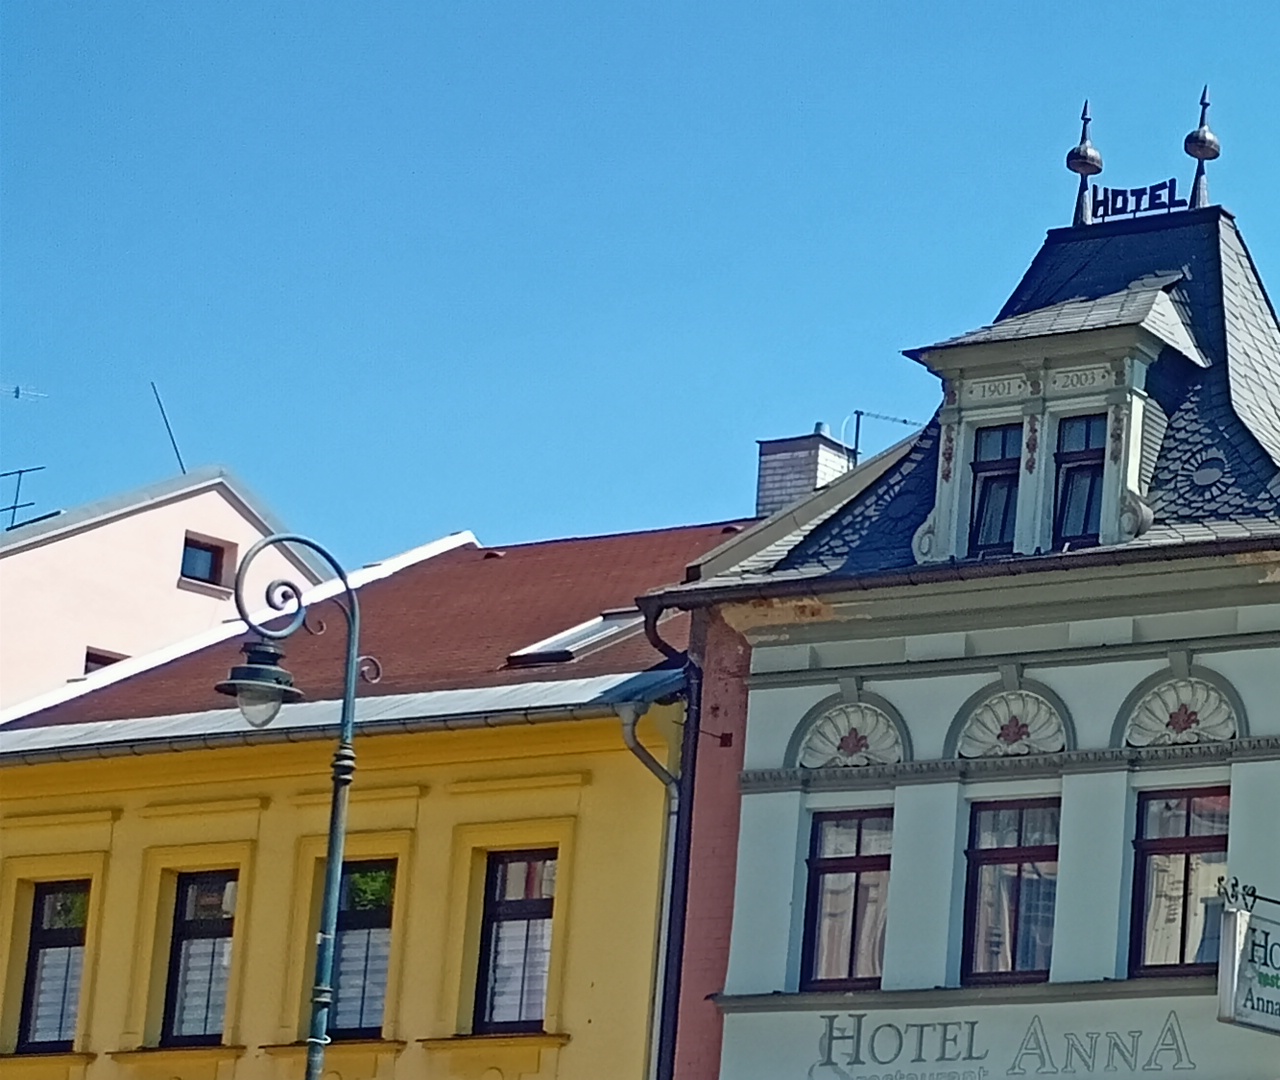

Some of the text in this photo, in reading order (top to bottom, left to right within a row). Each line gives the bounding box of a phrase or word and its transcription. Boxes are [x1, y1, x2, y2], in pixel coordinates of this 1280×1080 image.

[1092, 177, 1189, 219] HOTEL
[818, 1009, 1198, 1076] HOTEL ANNA
